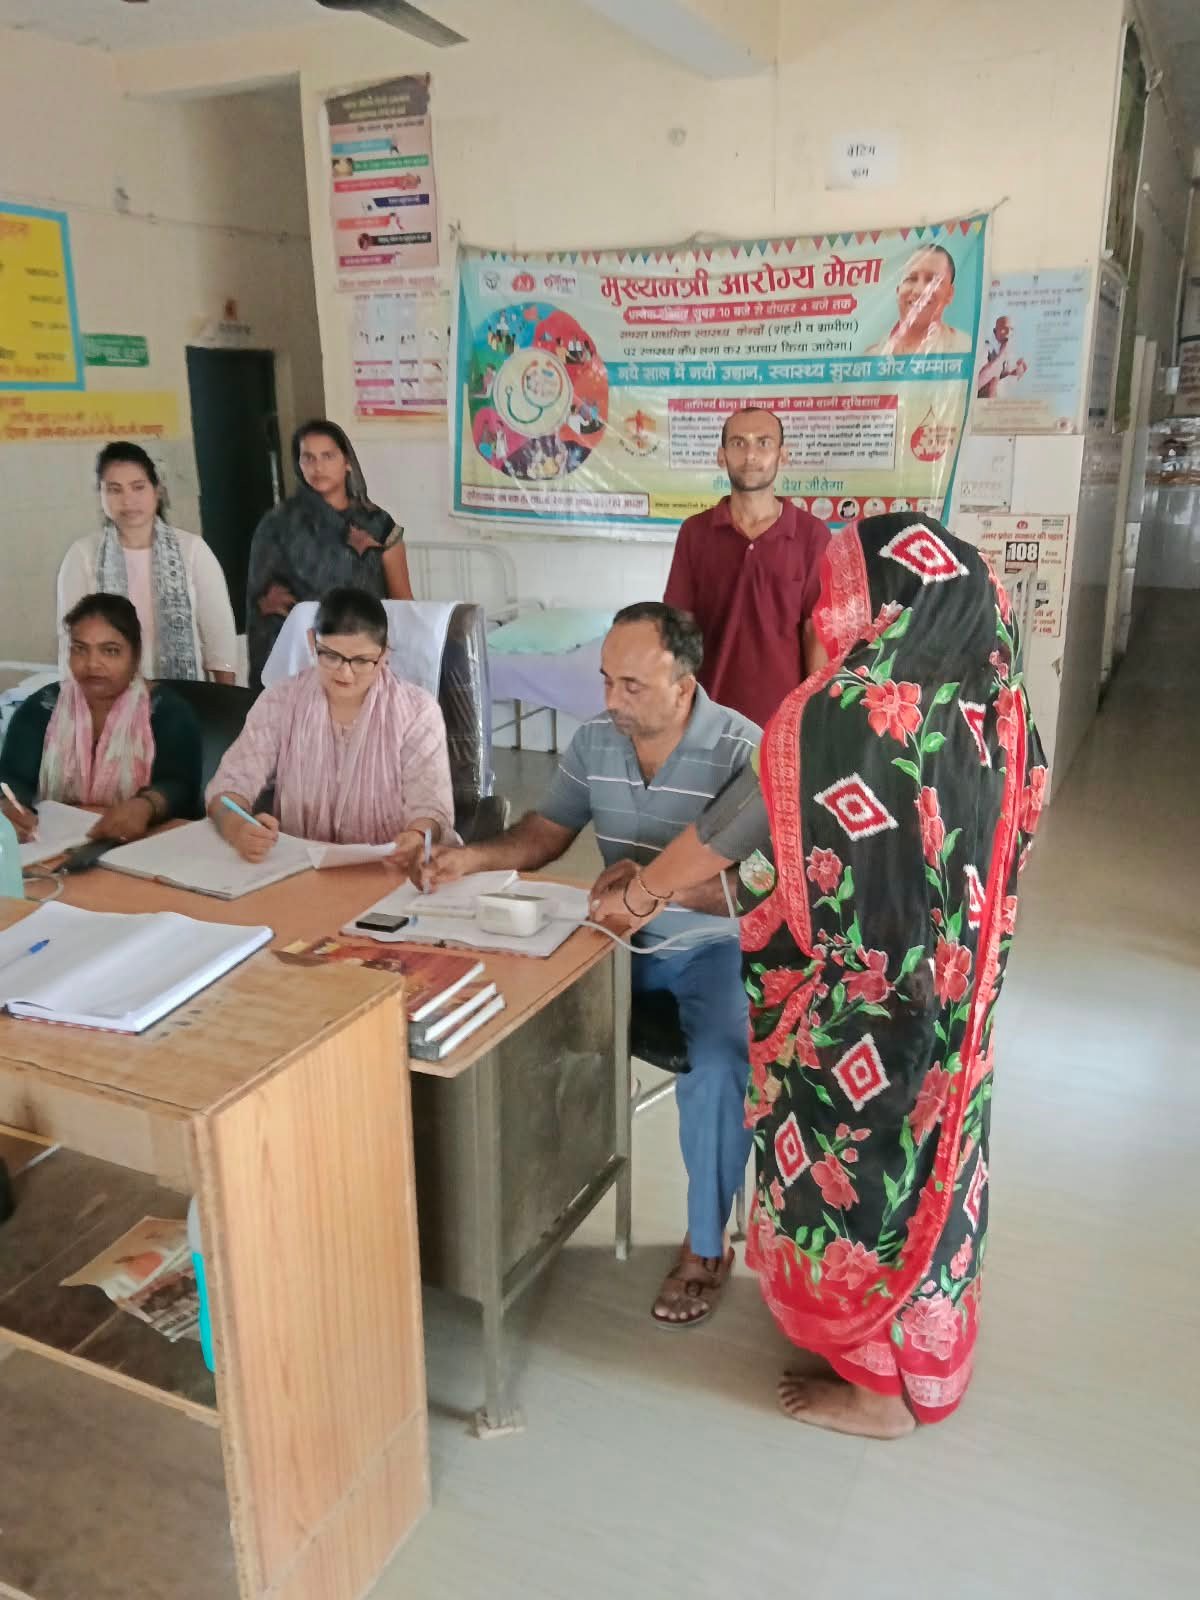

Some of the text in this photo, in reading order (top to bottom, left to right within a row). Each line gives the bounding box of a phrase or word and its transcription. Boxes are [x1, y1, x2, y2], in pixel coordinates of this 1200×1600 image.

[600, 267, 709, 307] मुख्यमंत्री
[718, 263, 815, 297] आरोग्य
[823, 255, 884, 288] मेला
[720, 308, 730, 318] 10
[734, 304, 751, 317] बजे
[753, 303, 764, 316] से
[767, 301, 797, 315] दोपहर
[800, 303, 807, 312] 4
[811, 298, 829, 312] बजे
[832, 299, 851, 310] तक
[805, 323, 815, 333] व
[817, 319, 859, 335] ग्रामीण)
[723, 345, 742, 355] कर
[745, 343, 777, 354] उपचार
[781, 340, 808, 353] किया
[673, 362, 686, 381] में
[768, 362, 826, 380] स्वास्थ्य
[829, 359, 872, 383] सुरक्षा
[877, 354, 906, 377] और
[910, 359, 963, 374] सम्मान
[781, 474, 801, 492] देश
[804, 472, 845, 492] जीतेगा
[1007, 542, 1038, 562] 108
